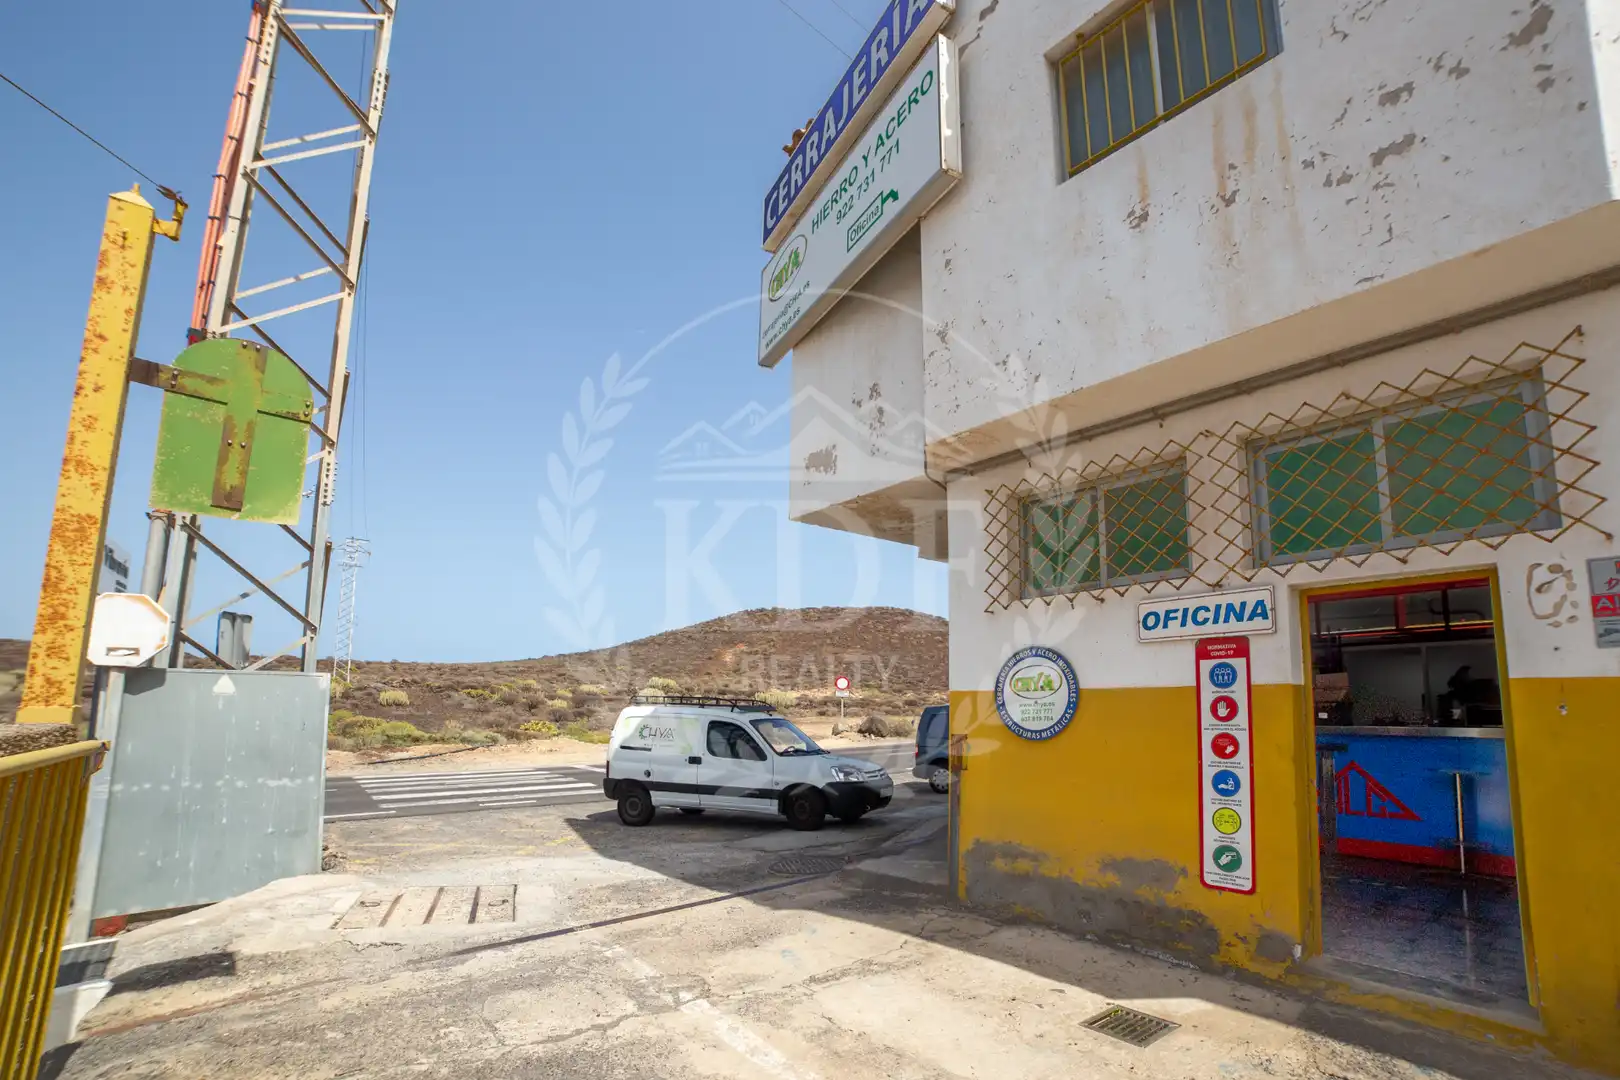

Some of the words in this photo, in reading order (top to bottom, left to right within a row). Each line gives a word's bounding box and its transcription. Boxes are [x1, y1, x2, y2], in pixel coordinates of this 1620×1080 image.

[812, 165, 858, 234] HIERRO
[862, 146, 872, 168] Y
[874, 70, 933, 156] ACERO
[836, 194, 854, 225] 922
[857, 168, 875, 201] 731
[879, 138, 900, 172] 771
[850, 204, 880, 242] Oficina
[1141, 599, 1269, 631] OFICINA
[1037, 649, 1058, 661] ACERO
[1000, 710, 1041, 739] ESTRUCTURAS
